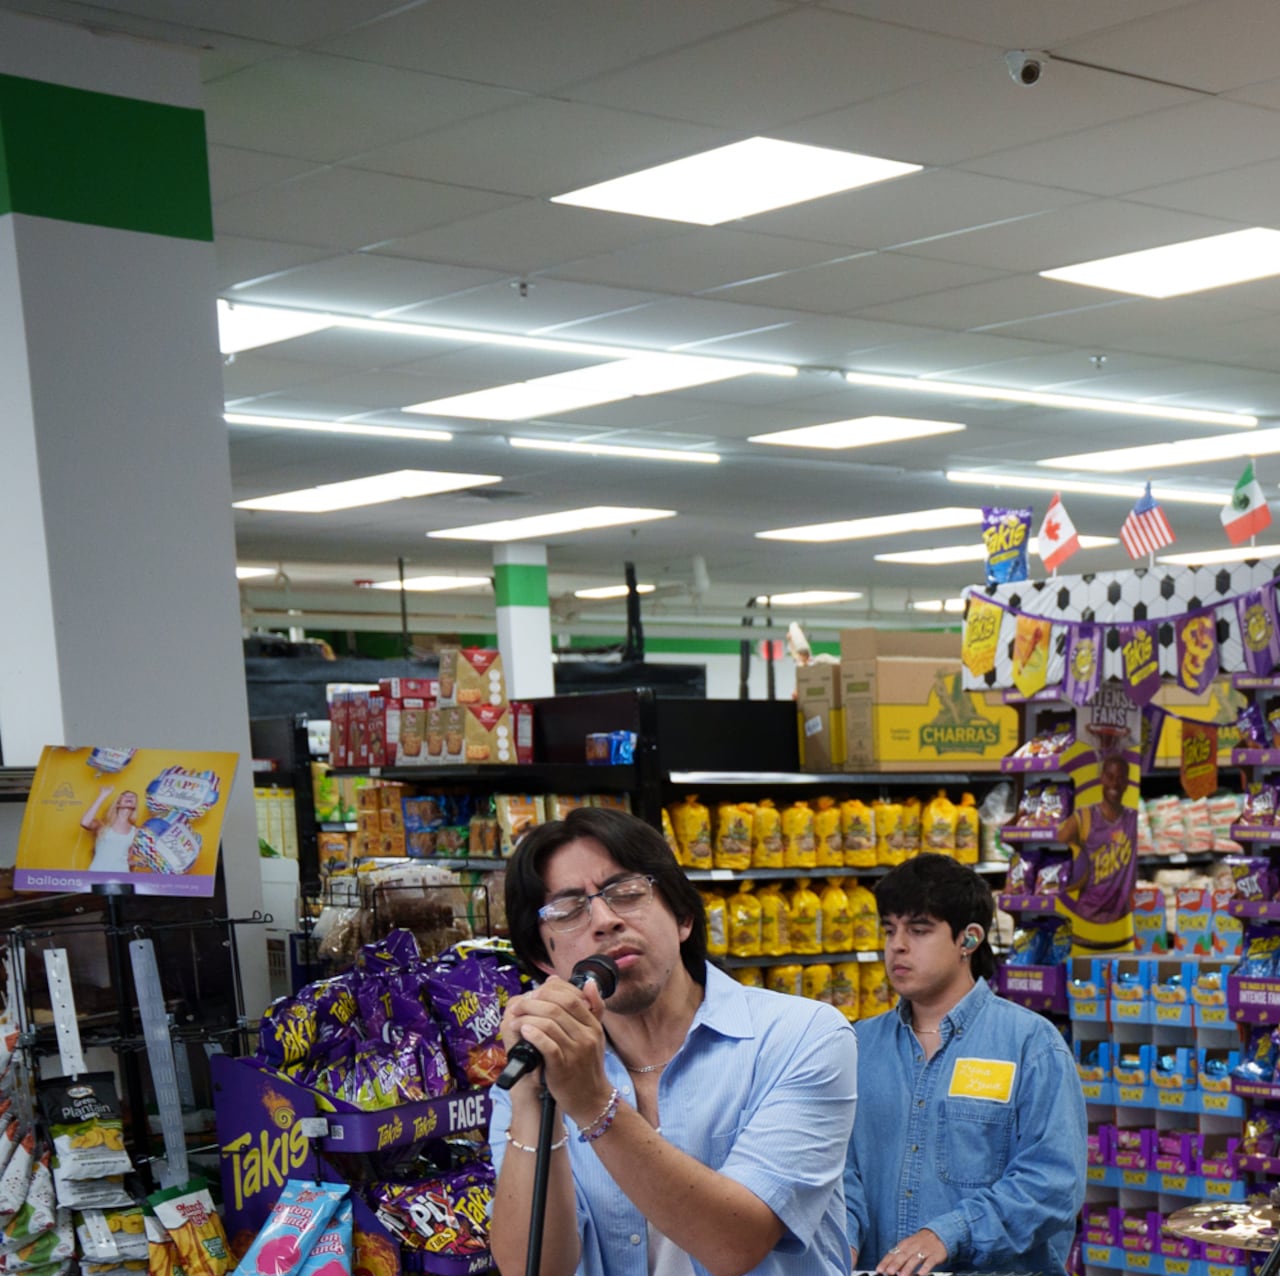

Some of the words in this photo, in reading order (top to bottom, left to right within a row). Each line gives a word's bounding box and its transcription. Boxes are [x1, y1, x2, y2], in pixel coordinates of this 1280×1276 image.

[983, 519, 1026, 556] Takis
[1122, 630, 1153, 678] Takis
[1092, 709, 1127, 728] FANS
[921, 726, 998, 744] CHARRAS
[27, 875, 83, 887] balloons
[61, 1102, 112, 1119] Plantain
[448, 1094, 487, 1131] FACE
[378, 1116, 403, 1150] Takis
[412, 1110, 438, 1143] Takis
[222, 1112, 310, 1211] Takis
[310, 1241, 346, 1257] andy
